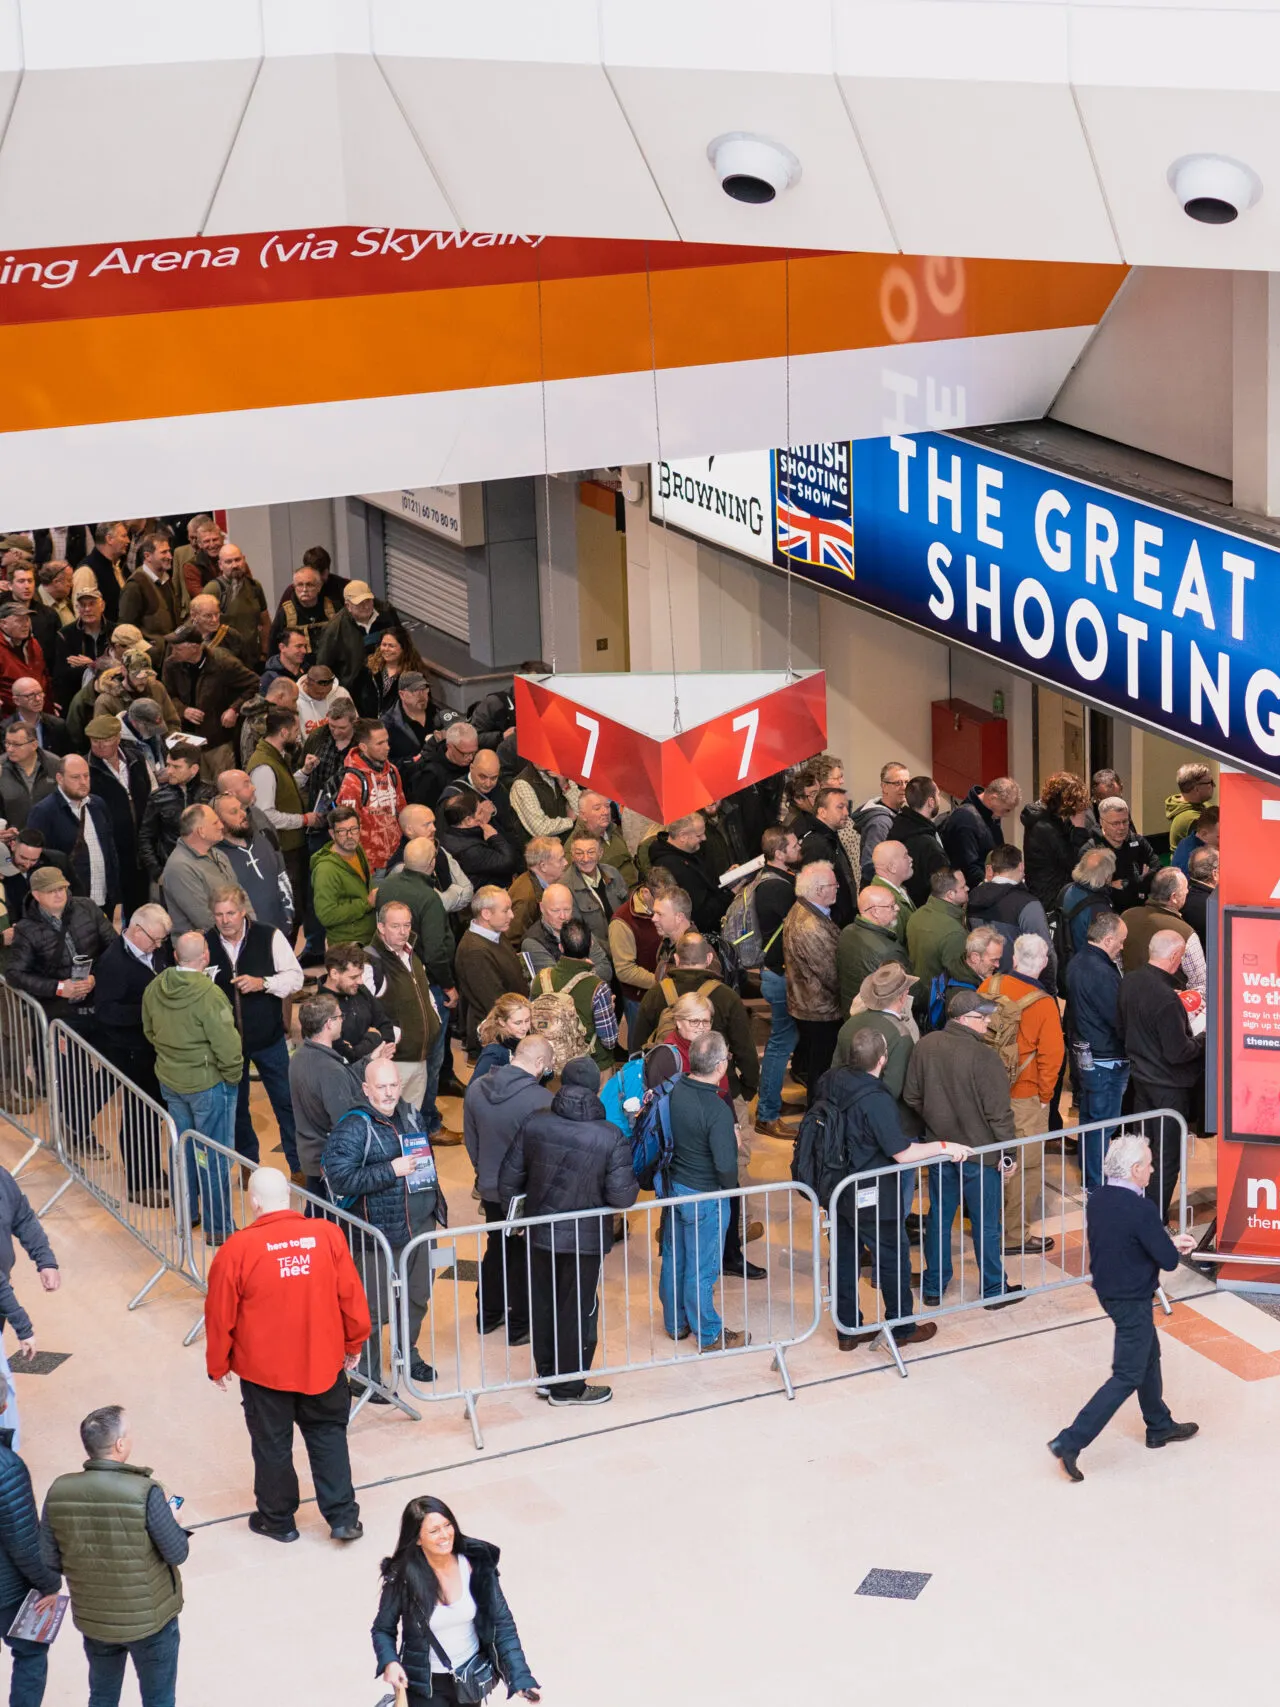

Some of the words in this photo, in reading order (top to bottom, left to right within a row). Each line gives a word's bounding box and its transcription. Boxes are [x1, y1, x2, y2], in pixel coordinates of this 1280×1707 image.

[0, 256, 78, 289] ing
[89, 247, 240, 277] Arena
[259, 233, 338, 268] (via
[350, 227, 547, 261] Skywa
[780, 442, 847, 473] ITISH
[780, 454, 848, 495] SHOOTING
[658, 461, 764, 536] BROWNING
[797, 482, 831, 508] SHOW
[431, 508, 439, 523] 70
[440, 513, 448, 527] 80
[450, 517, 458, 532] 90
[889, 434, 1003, 550] THE
[1034, 489, 1255, 641] GREAT
[576, 711, 600, 779] 7
[732, 708, 759, 780] 7
[1242, 991, 1262, 1004] to
[1242, 1010, 1260, 1019] Stay
[1263, 1011, 1271, 1019] in
[1242, 1021, 1259, 1030] sign
[266, 1242, 288, 1252] here
[289, 1240, 300, 1248] to
[277, 1254, 311, 1268] TEAM
[280, 1264, 310, 1278] nec
